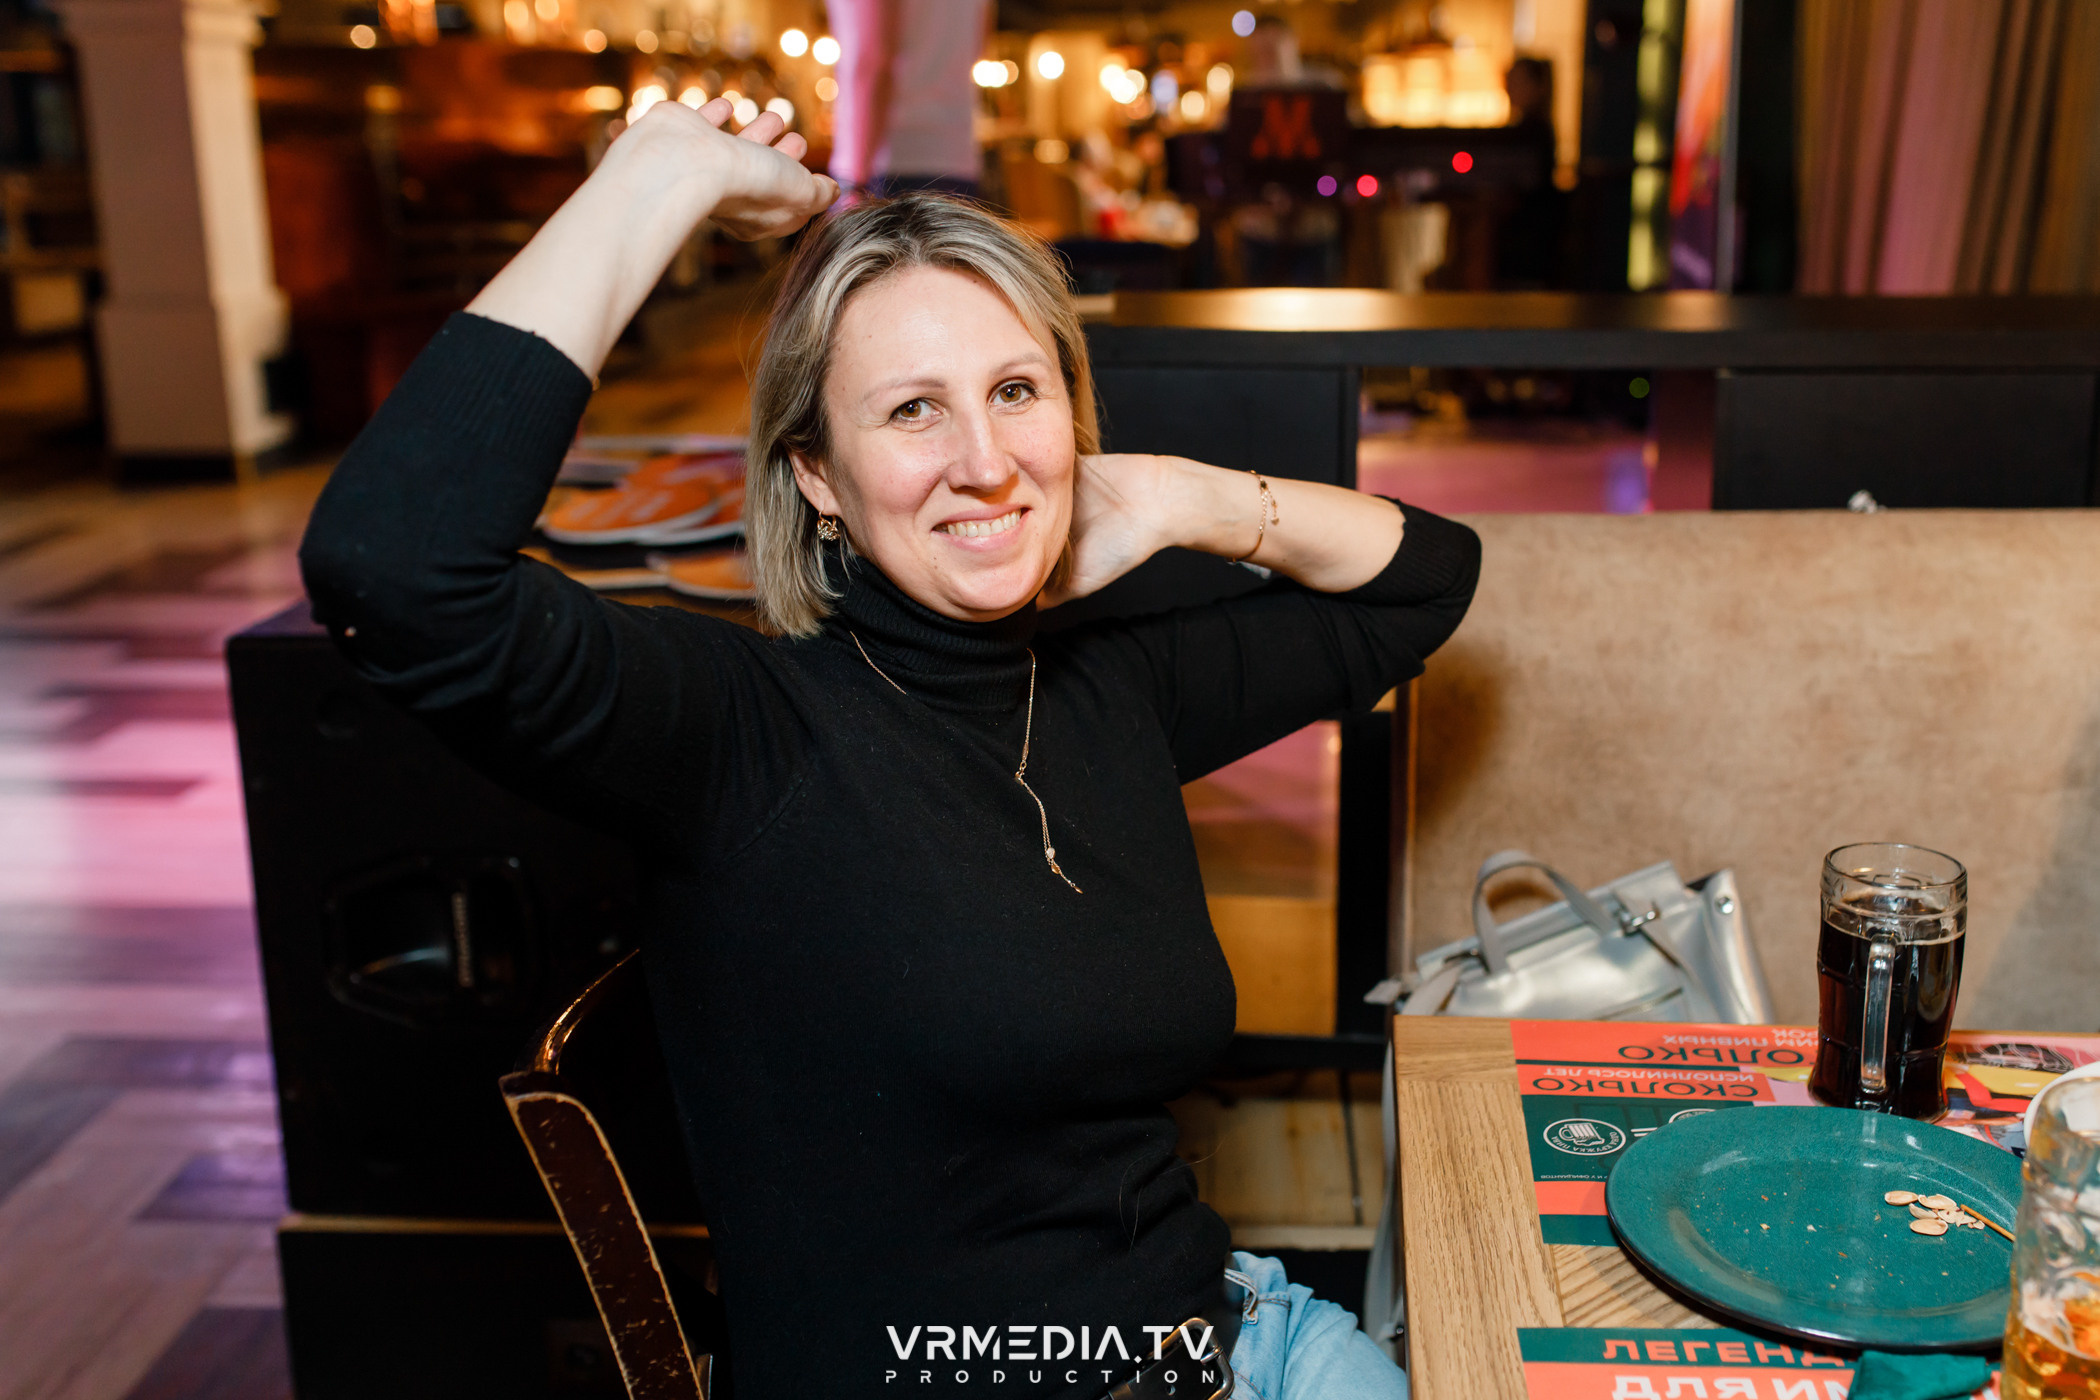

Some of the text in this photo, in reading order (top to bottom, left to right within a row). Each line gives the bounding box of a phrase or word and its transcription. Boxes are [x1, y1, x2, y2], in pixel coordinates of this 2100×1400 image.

[1662, 1035, 1768, 1047] ПИВНЫХ
[1618, 1046, 1815, 1065] ОЛЬКО
[1543, 1067, 1754, 1082] ИСПОЛНИЛОСЬ ЛЕТ
[1532, 1077, 1758, 1098] СКОЛЬКО
[1603, 1339, 1857, 1367] ЛЕГЕНД
[1612, 1375, 1758, 1400] ДЛЯ
